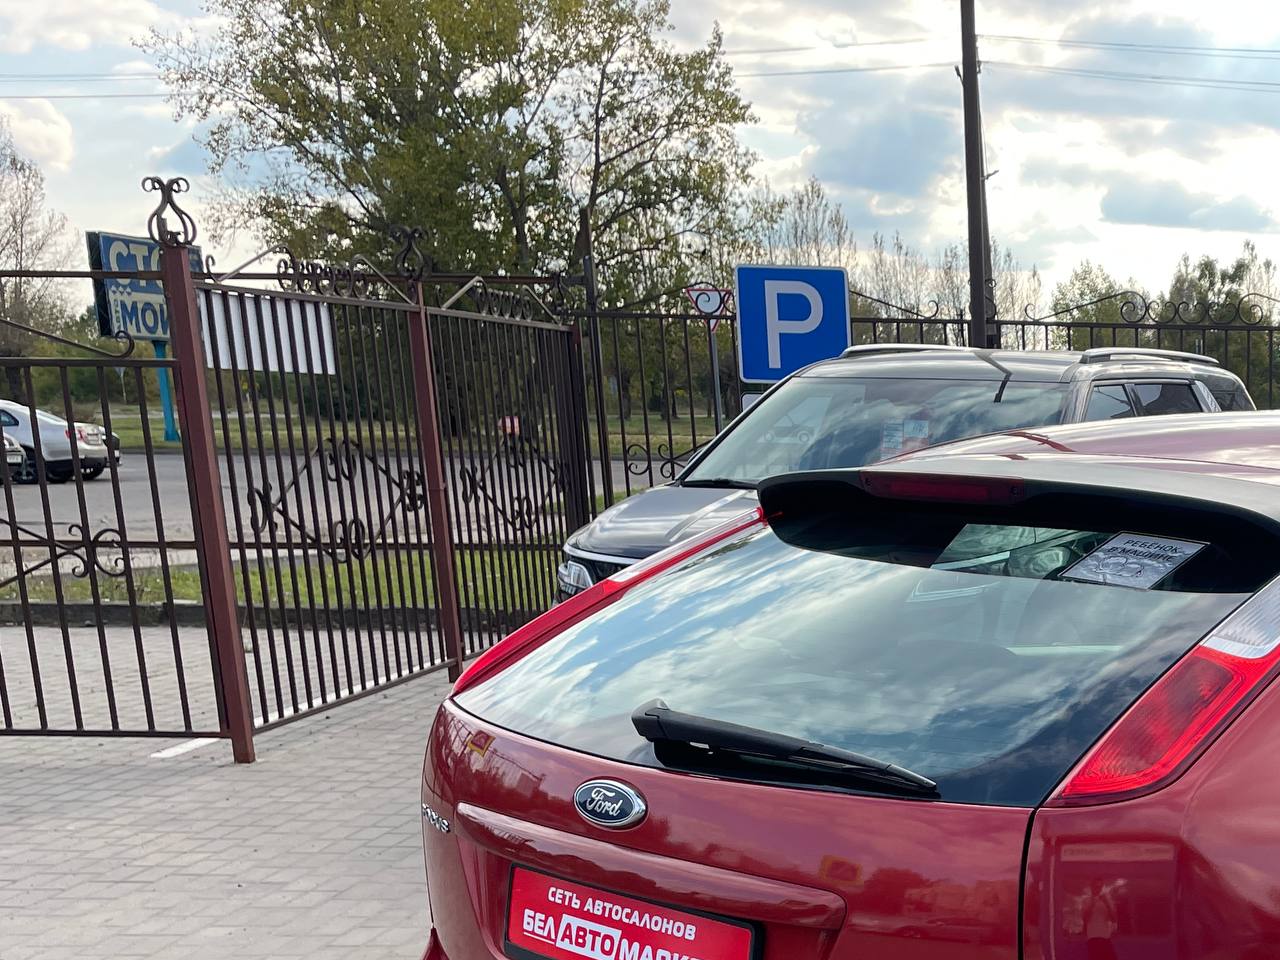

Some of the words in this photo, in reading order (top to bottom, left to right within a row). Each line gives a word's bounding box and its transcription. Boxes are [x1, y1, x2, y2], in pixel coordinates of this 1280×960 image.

[764, 279, 824, 369] P
[586, 787, 624, 818] Ford
[547, 886, 581, 910] СЕТЬ
[583, 897, 697, 941] АВТОСАЛОНОВ
